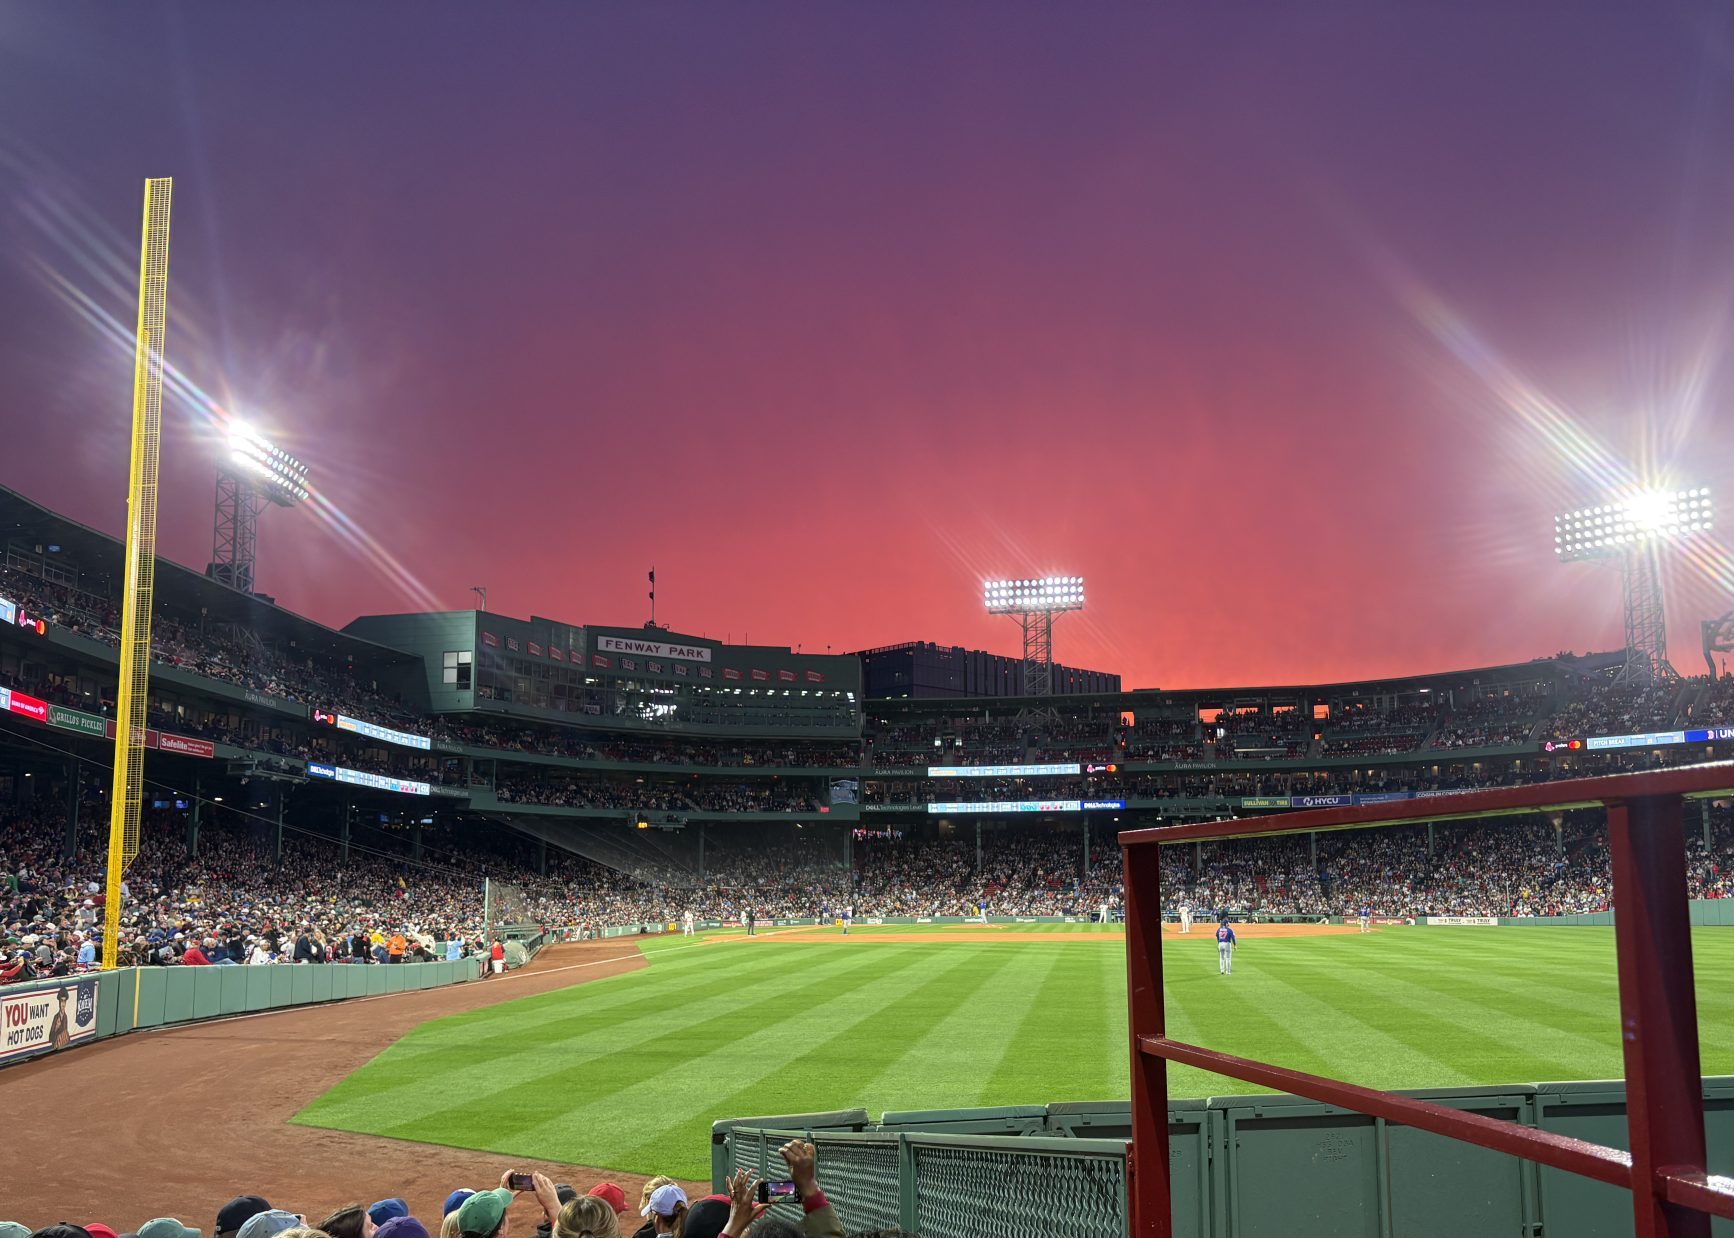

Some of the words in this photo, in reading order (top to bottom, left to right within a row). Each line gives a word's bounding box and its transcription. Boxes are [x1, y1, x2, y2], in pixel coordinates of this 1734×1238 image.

[606, 640, 661, 654] FENWAY
[670, 647, 704, 659] PARK
[81, 718, 103, 731] PICKLES
[161, 738, 188, 750] Safelite
[5, 1002, 28, 1028] YOU
[29, 1003, 49, 1020] WANT
[7, 1029, 24, 1046] HOT
[26, 1025, 43, 1042] DOGS
